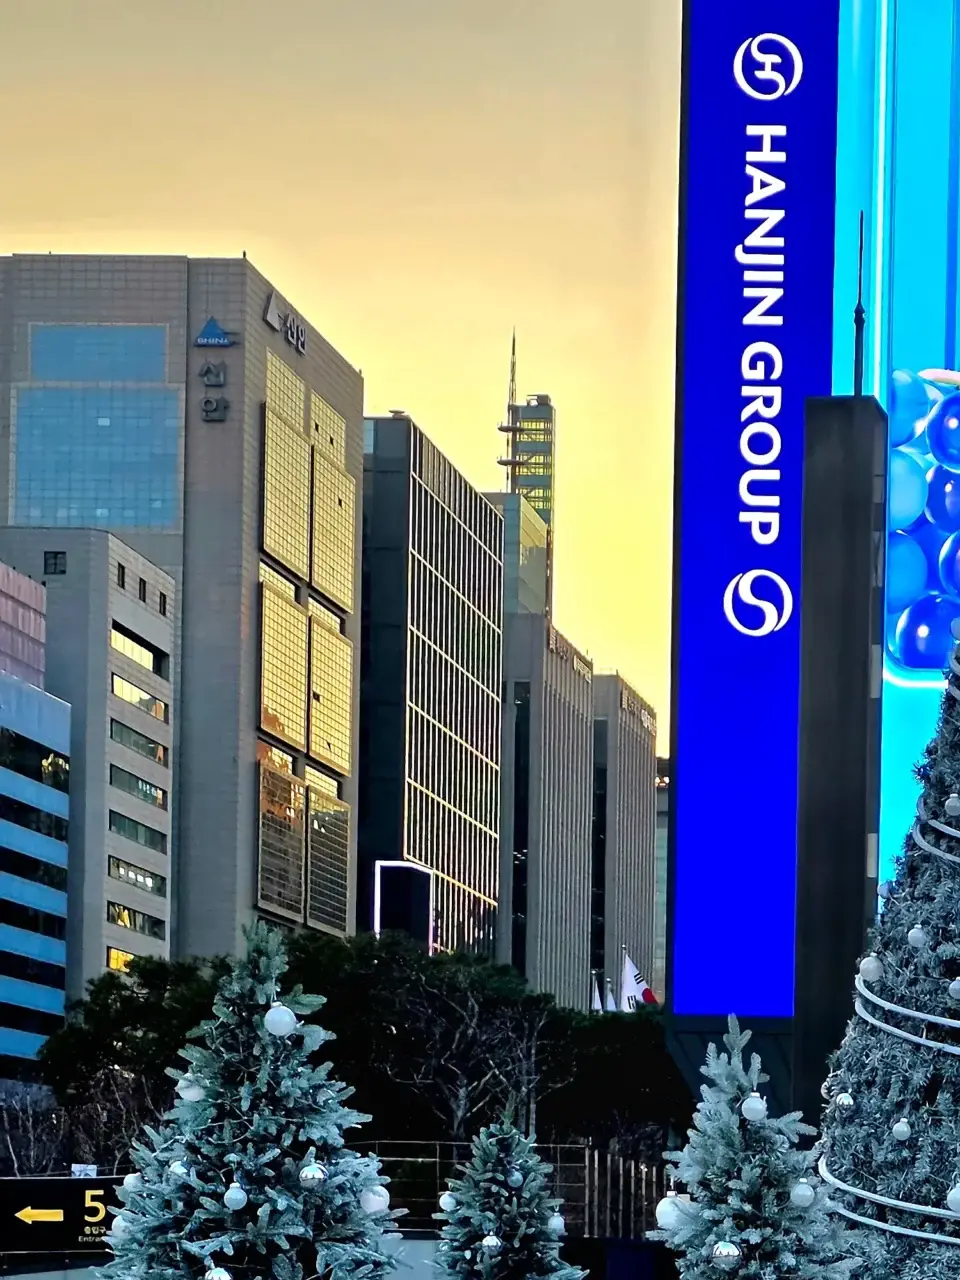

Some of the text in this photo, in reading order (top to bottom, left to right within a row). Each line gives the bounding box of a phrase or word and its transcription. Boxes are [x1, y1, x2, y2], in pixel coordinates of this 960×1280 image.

[734, 124, 788, 545] HANJIN GROUP
[84, 1190, 106, 1222] 5
